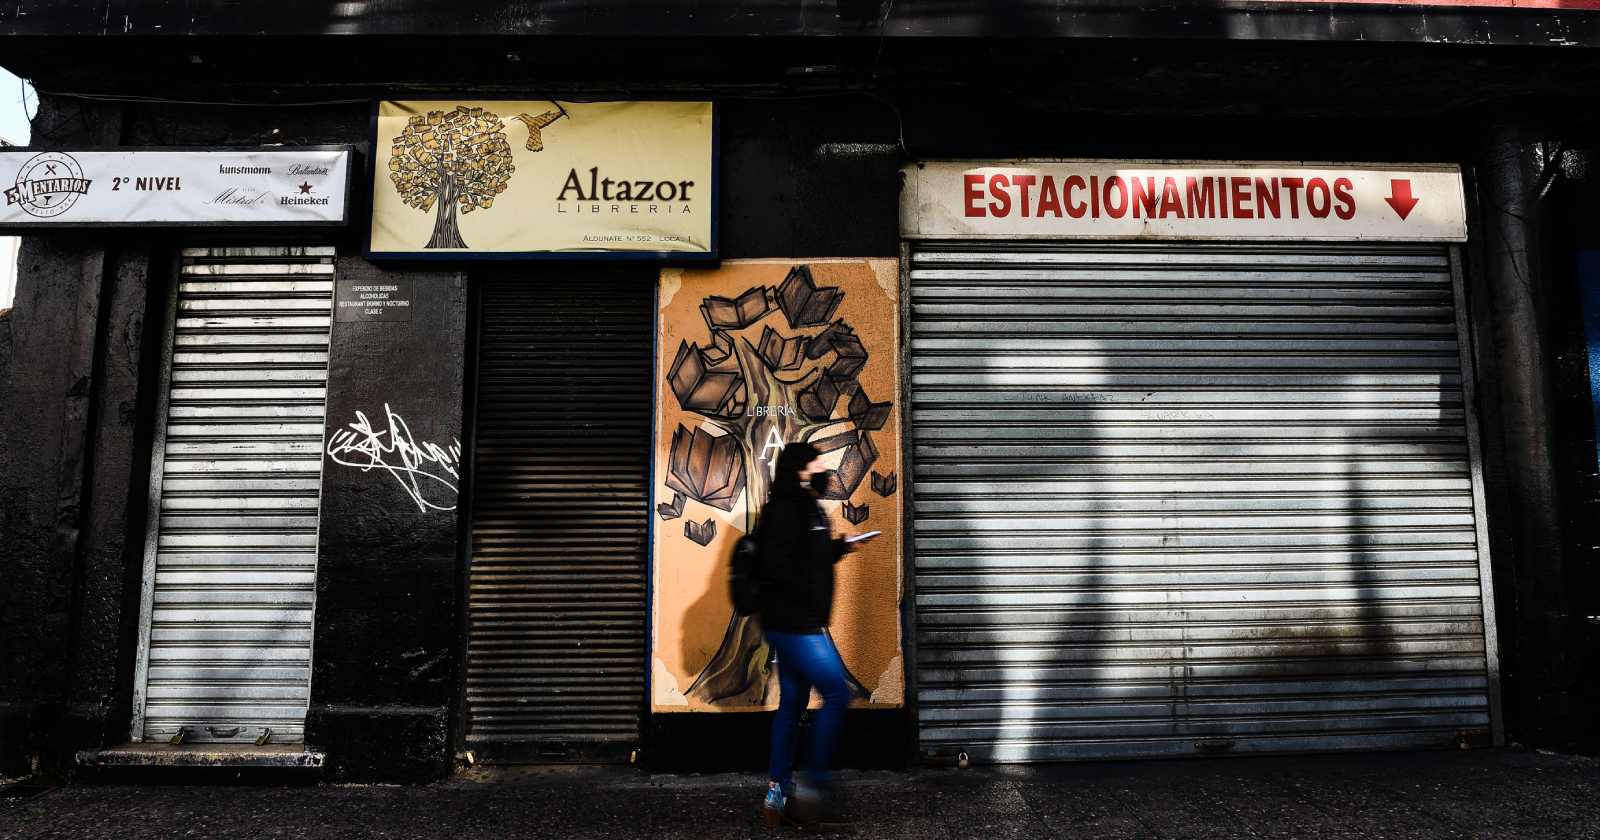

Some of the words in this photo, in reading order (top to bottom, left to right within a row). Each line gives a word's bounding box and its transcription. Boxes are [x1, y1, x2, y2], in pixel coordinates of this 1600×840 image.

[219, 164, 271, 174] kunstmann
[135, 176, 182, 191] NIVEL
[556, 166, 695, 201] Altazor
[280, 196, 329, 205] Heineken
[963, 174, 1357, 220] ESTACIONAMIENTOS
[557, 202, 692, 214] LIBRERIA
